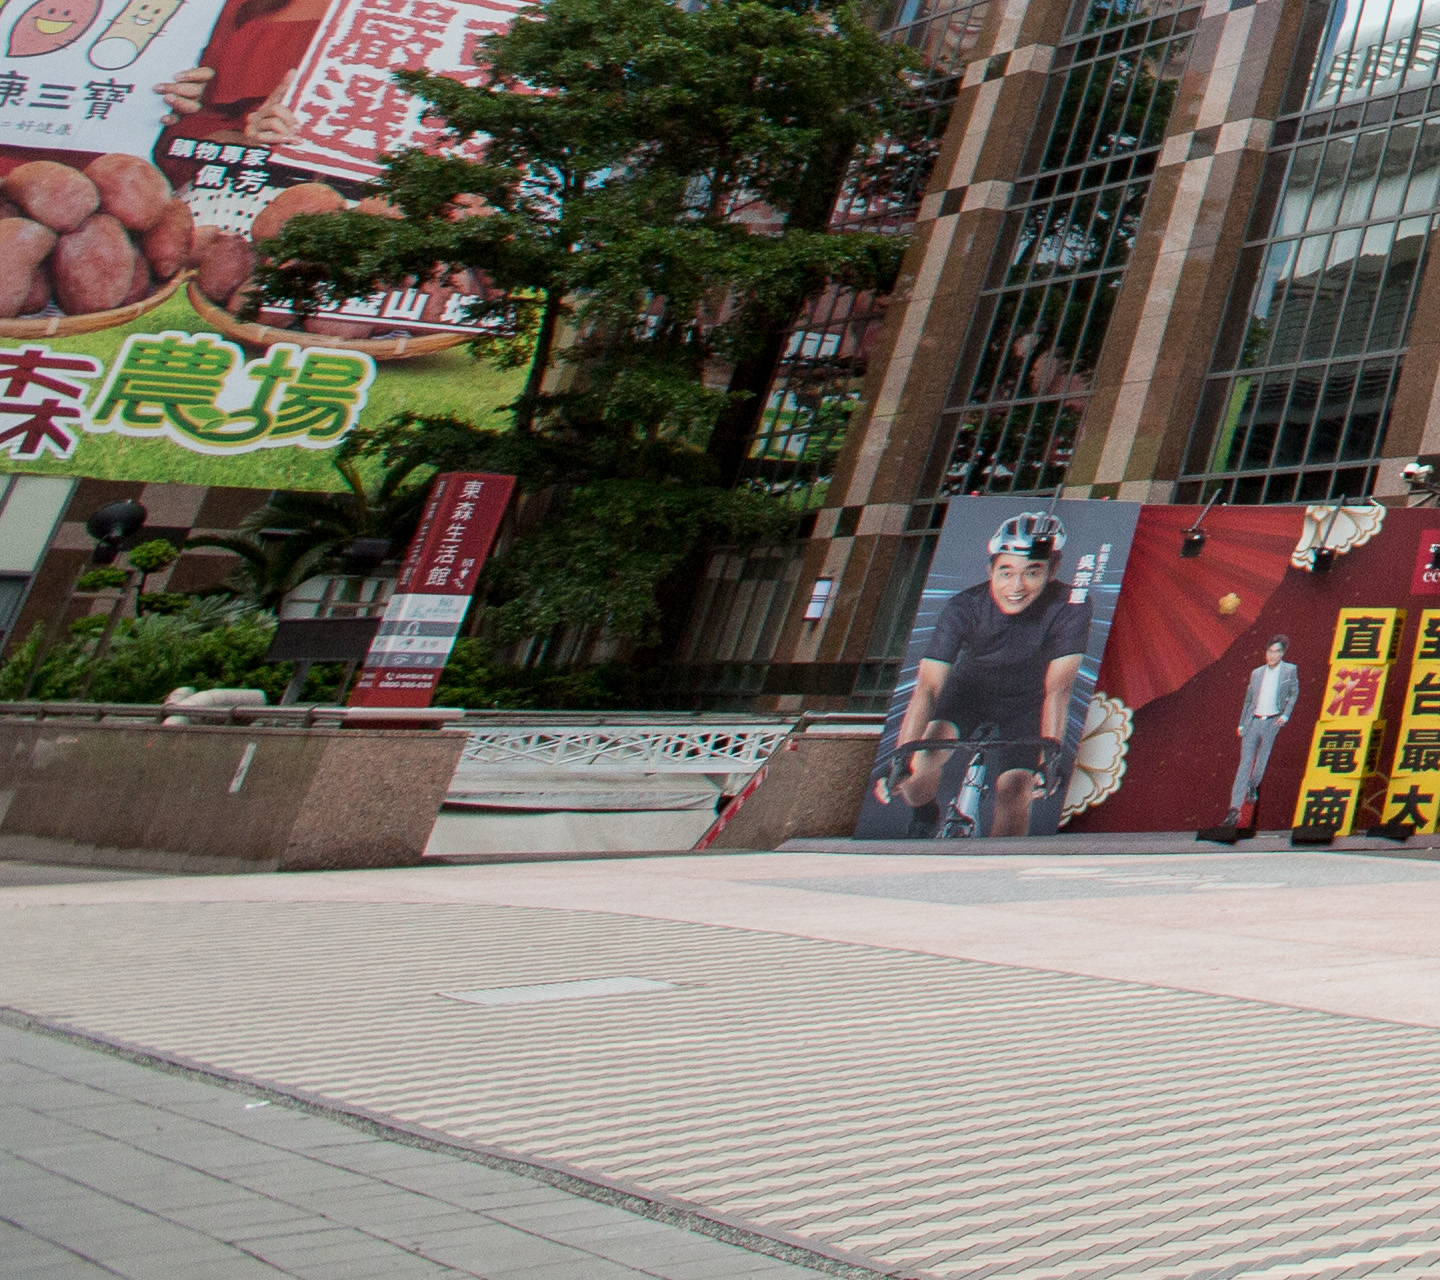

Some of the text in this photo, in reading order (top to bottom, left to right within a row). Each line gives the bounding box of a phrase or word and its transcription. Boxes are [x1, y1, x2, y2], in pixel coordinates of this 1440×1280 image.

[426, 480, 485, 586] 東森生活館
[1301, 617, 1387, 833] 直消電商
